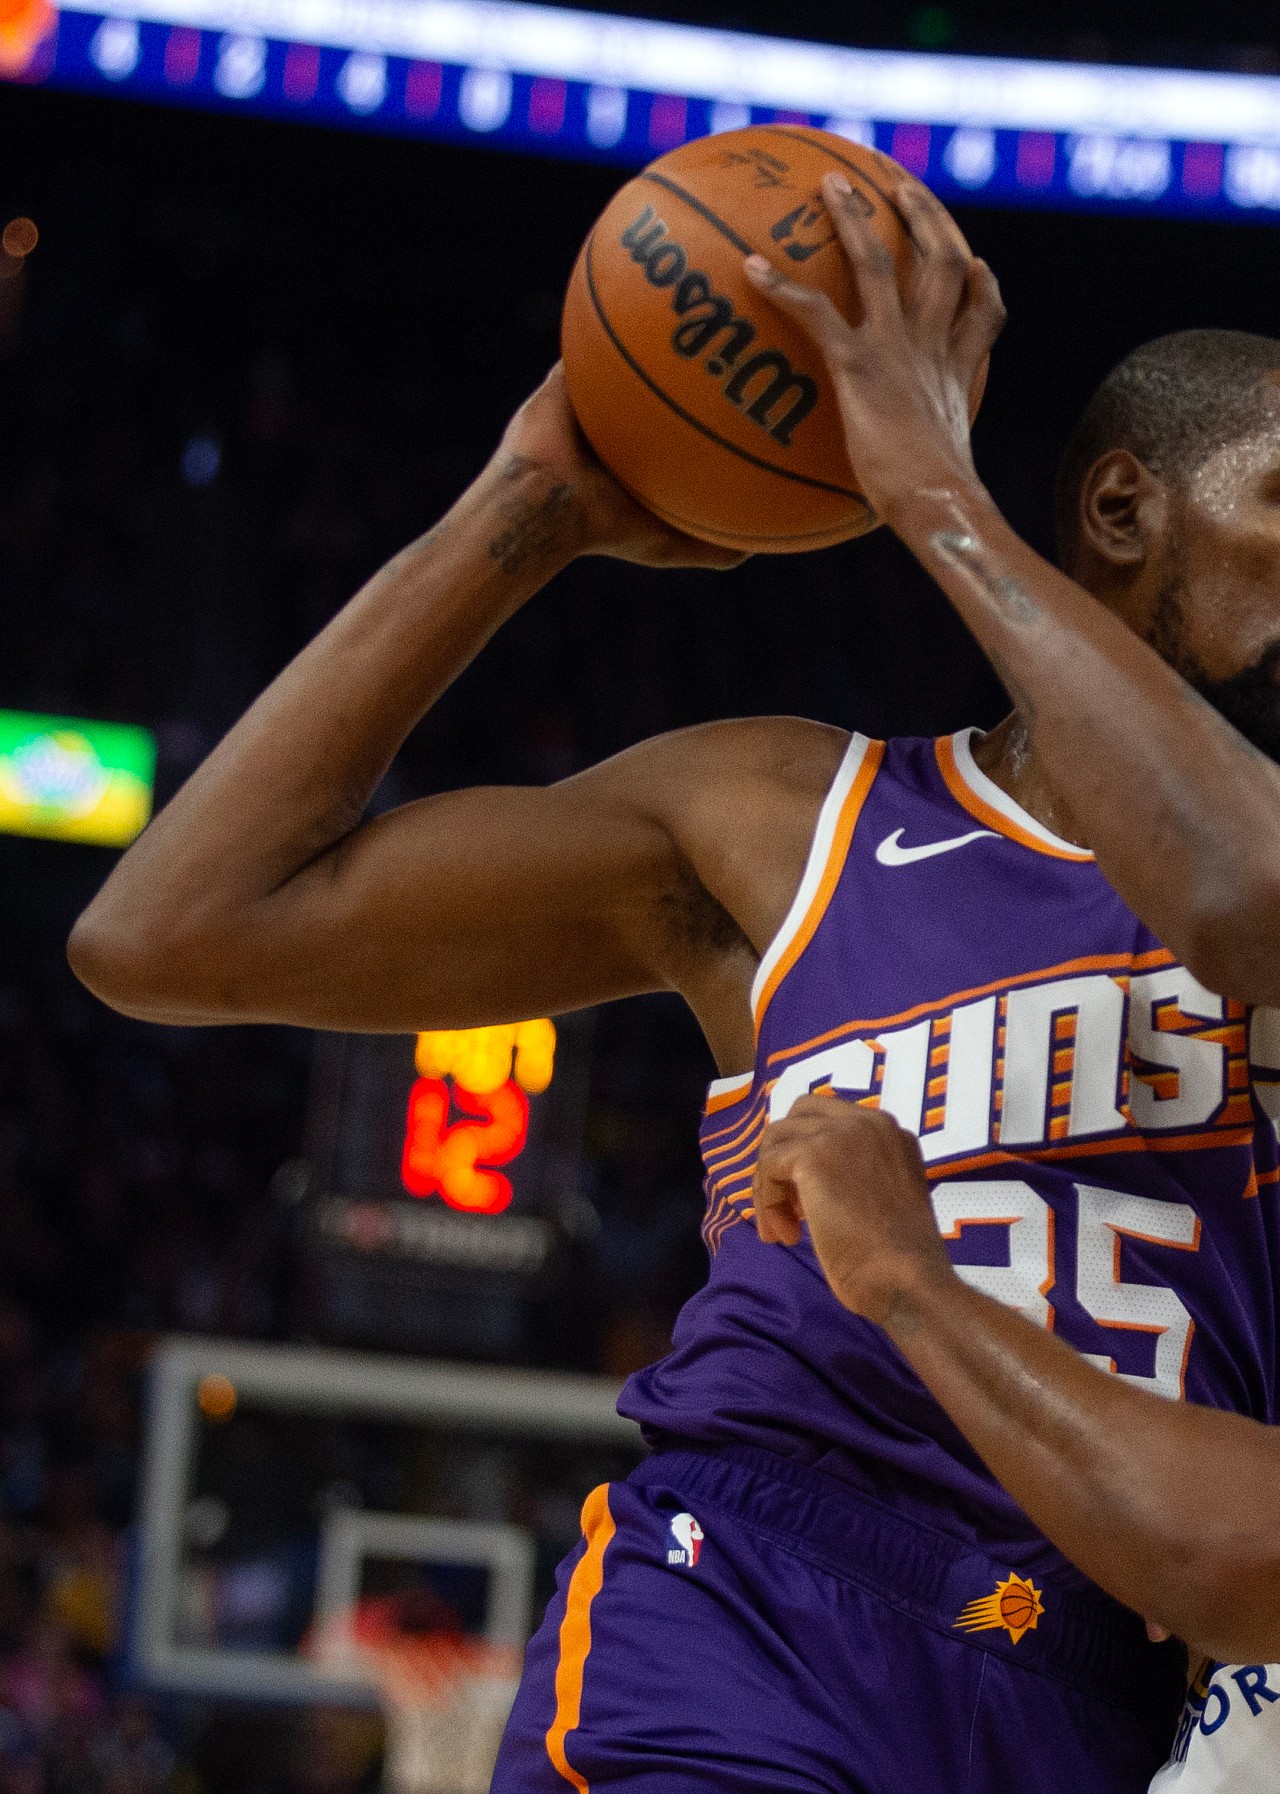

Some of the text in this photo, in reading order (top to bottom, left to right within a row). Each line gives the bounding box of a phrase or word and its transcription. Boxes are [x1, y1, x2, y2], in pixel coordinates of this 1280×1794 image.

[620, 204, 819, 448] Wilson
[930, 1179, 1201, 1401] 35
[668, 1549, 686, 1564] NBA
